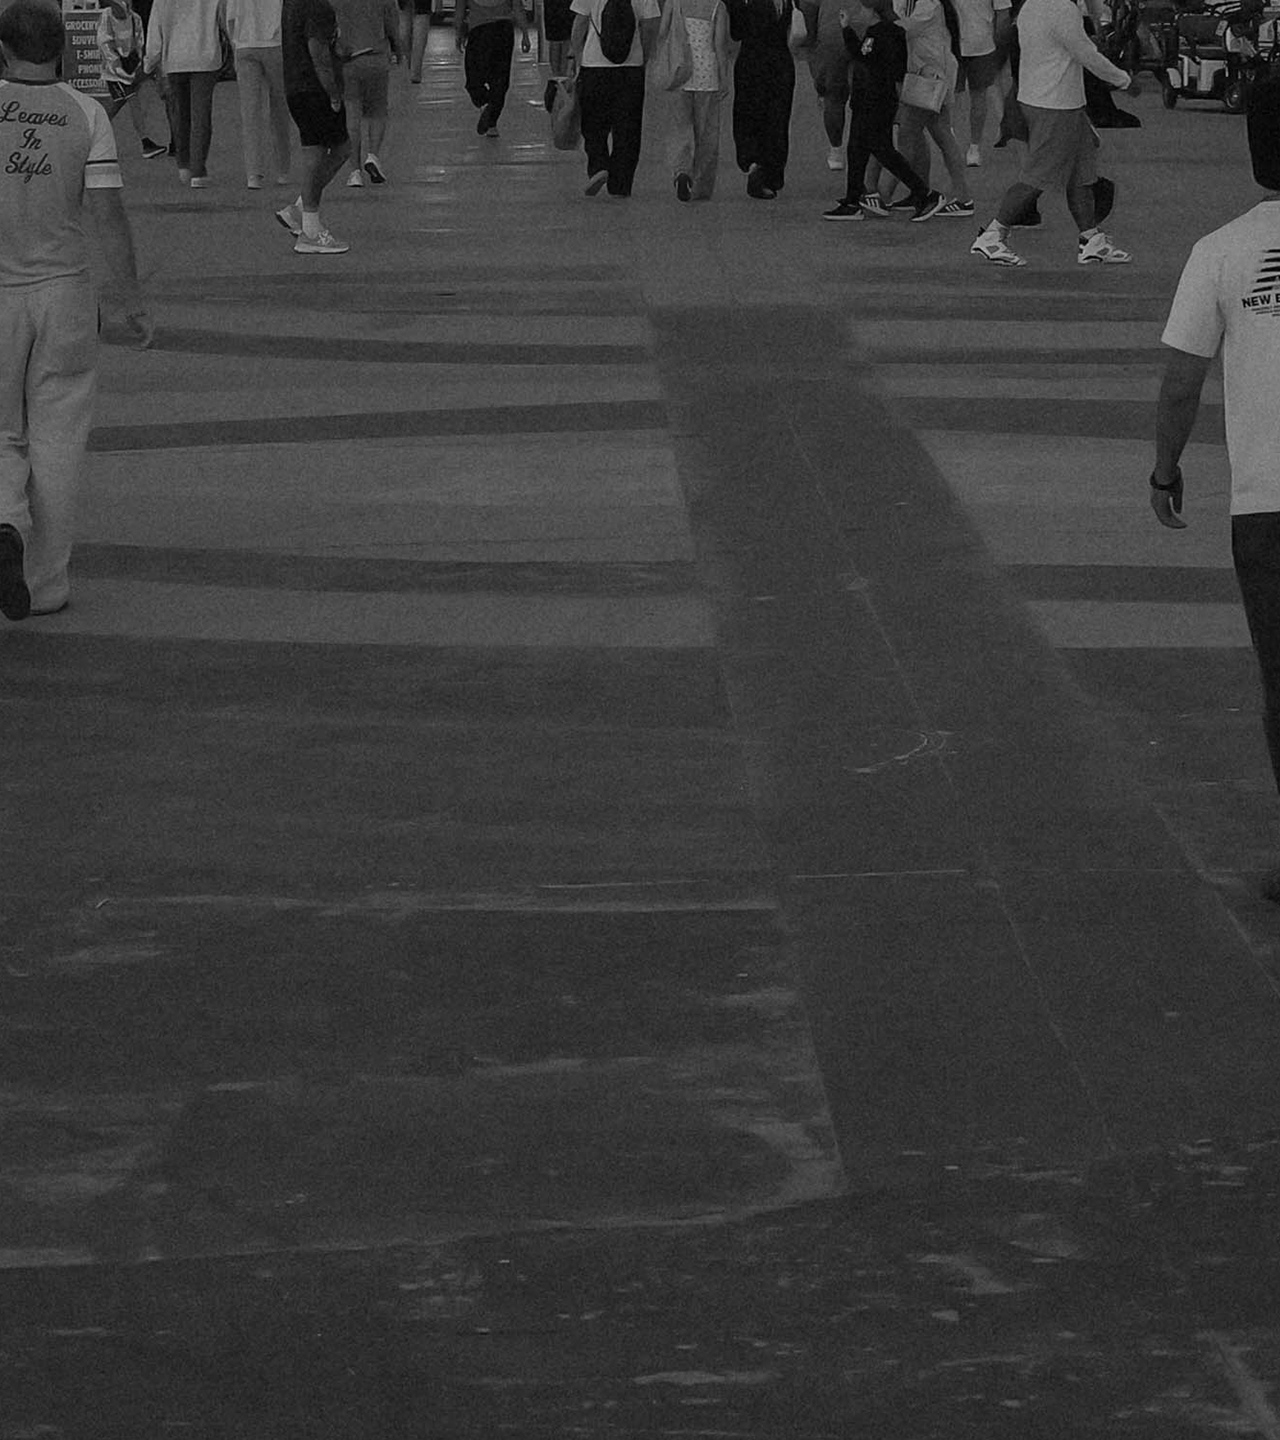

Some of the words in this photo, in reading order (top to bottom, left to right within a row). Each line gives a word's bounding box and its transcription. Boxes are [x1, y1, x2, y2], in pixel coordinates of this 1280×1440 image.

[19, 128, 42, 150] In
[5, 151, 52, 184] Style
[1241, 294, 1271, 308] NEW
